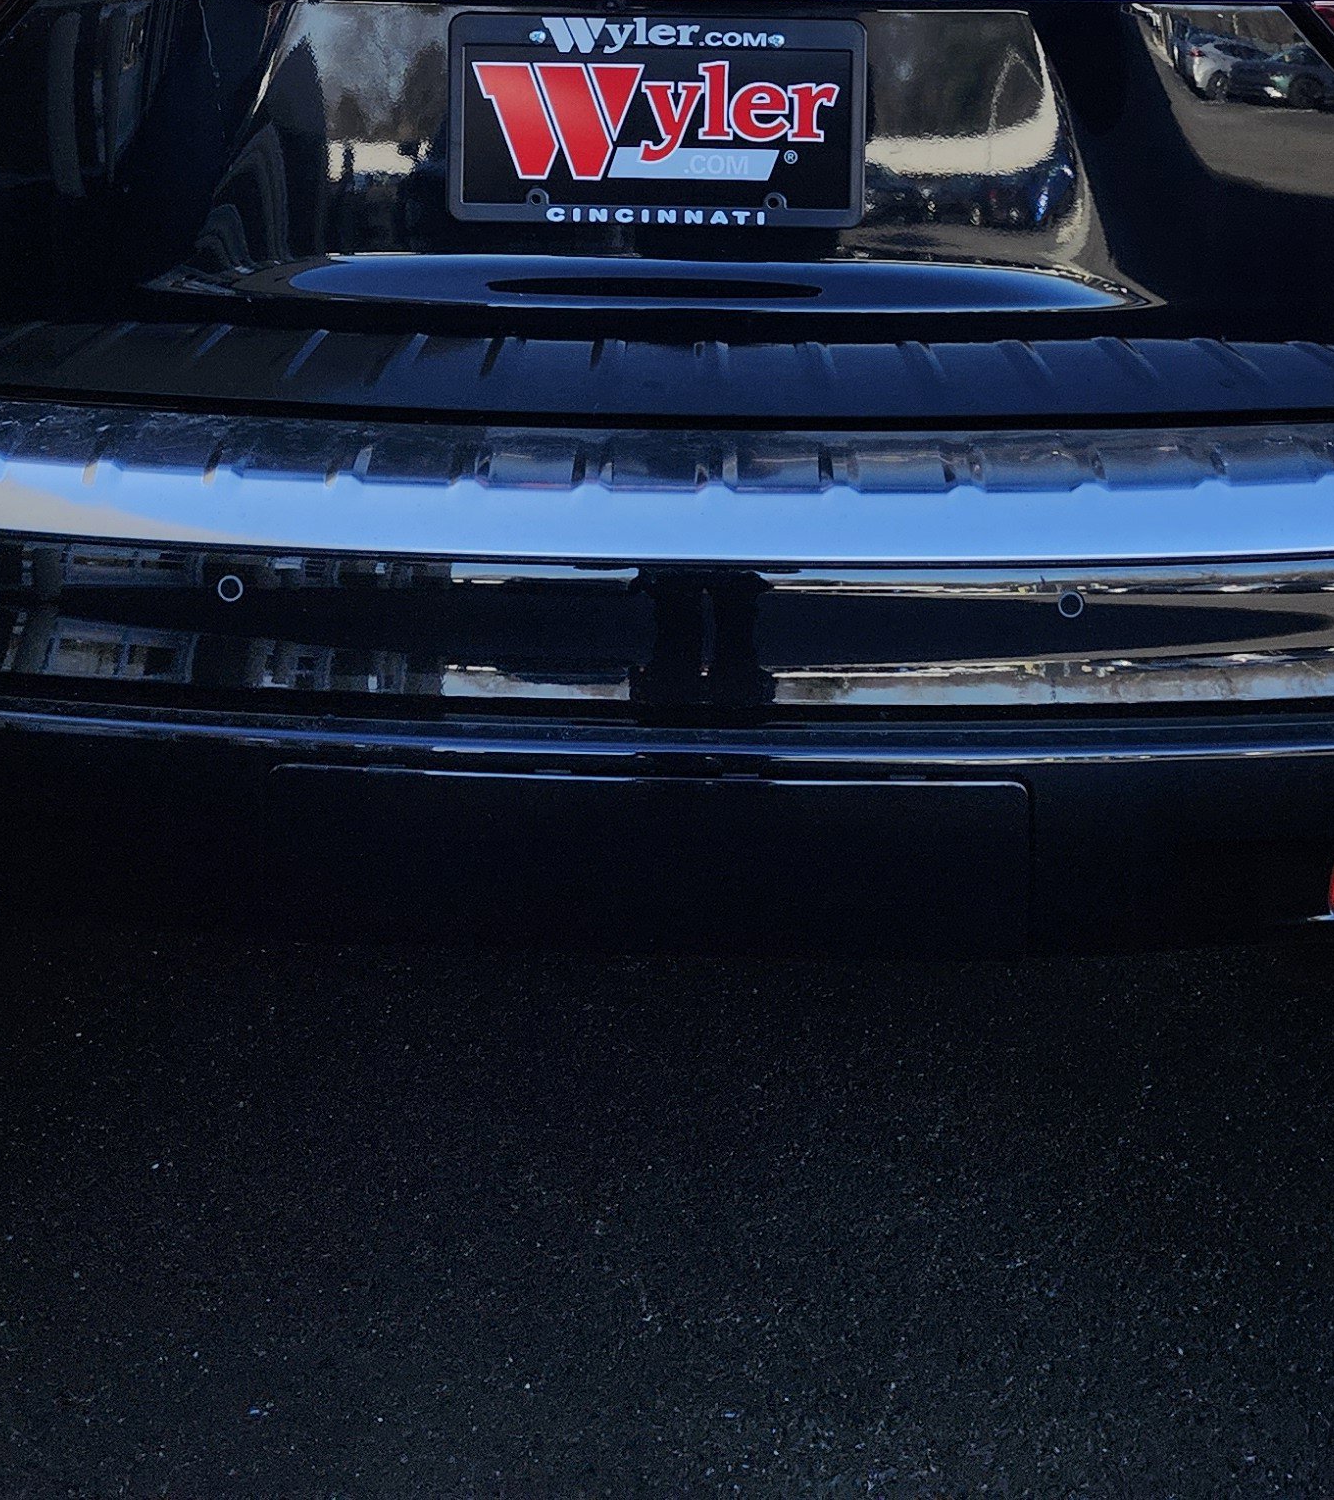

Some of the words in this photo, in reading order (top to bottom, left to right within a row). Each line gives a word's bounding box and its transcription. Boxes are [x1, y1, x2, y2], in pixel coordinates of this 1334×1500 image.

[471, 60, 840, 182] Wyler
[683, 154, 749, 176] .COM
[545, 206, 766, 227] CINCINNATI
